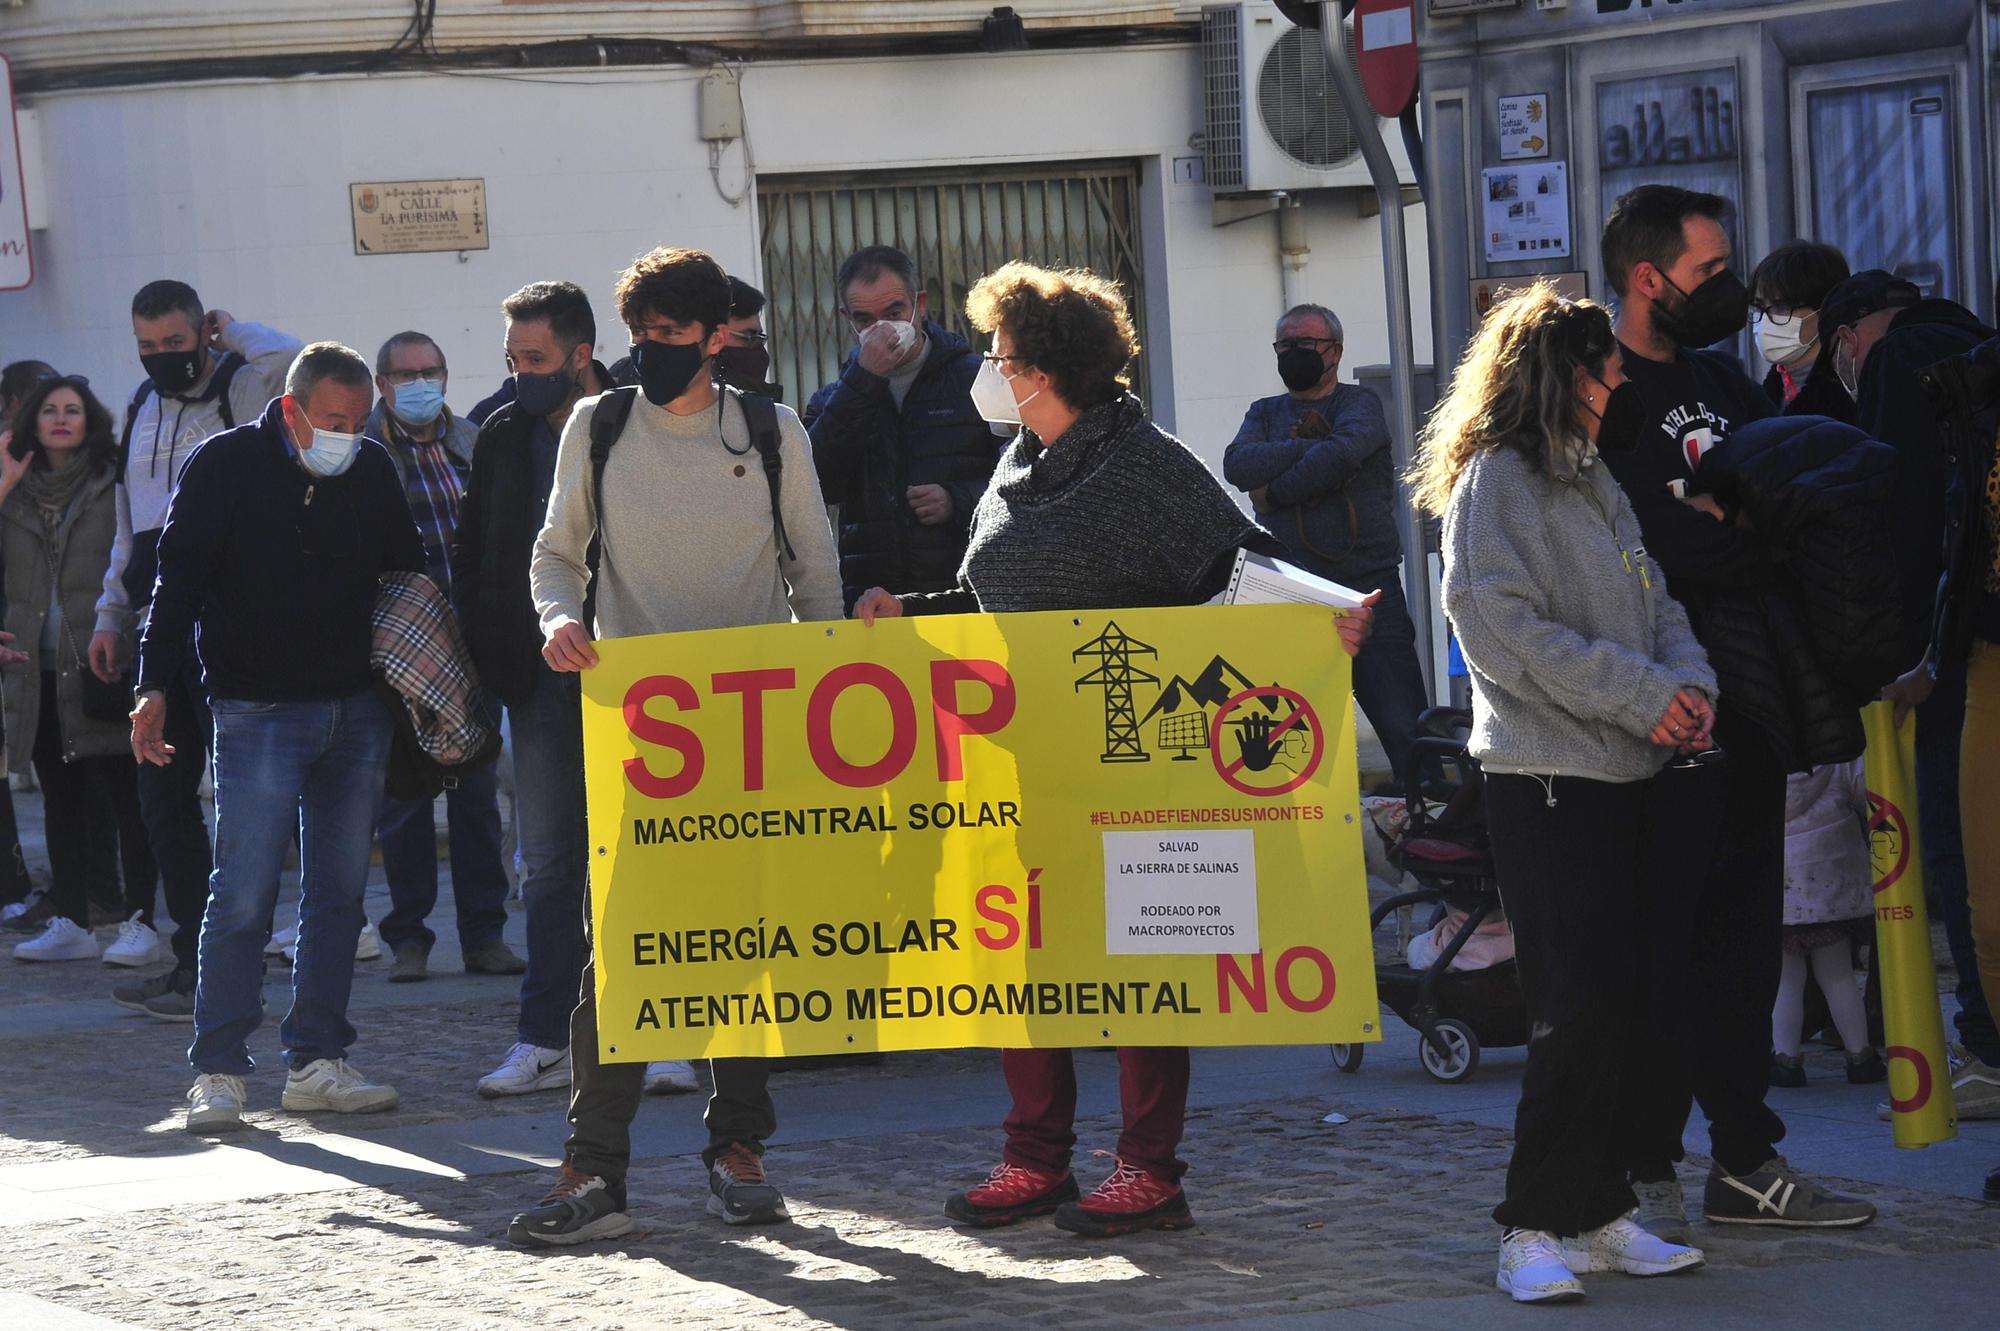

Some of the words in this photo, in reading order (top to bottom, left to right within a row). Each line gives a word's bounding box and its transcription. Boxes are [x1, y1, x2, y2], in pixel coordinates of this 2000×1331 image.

[1186, 162, 1192, 179] 1
[400, 198, 442, 210] CALLE
[381, 212, 395, 225] LA
[622, 659, 1017, 799] STOP
[634, 805, 898, 845] MACROCENTRAL
[908, 801, 1022, 830] SOLAR
[1090, 805, 1324, 826] #ELDADEFIENDESUSMONTES
[1158, 841, 1199, 853] SALVAD
[1120, 863, 1134, 874] LA
[1136, 863, 1175, 874] SIERRA
[1177, 863, 1190, 874] DE
[1192, 862, 1239, 874] SALINAS
[633, 917, 799, 966] ENERGÍA
[811, 918, 960, 957] SOLAR
[974, 868, 1043, 951] SÍ
[1140, 905, 1195, 917] RODEADO
[1197, 905, 1222, 917] POR
[1128, 925, 1235, 936] MACROPROYECTOS
[635, 989, 833, 1031] ATENTADO
[846, 981, 1201, 1021] MEDIOAMBIENTAL
[1216, 946, 1337, 1014] NO
